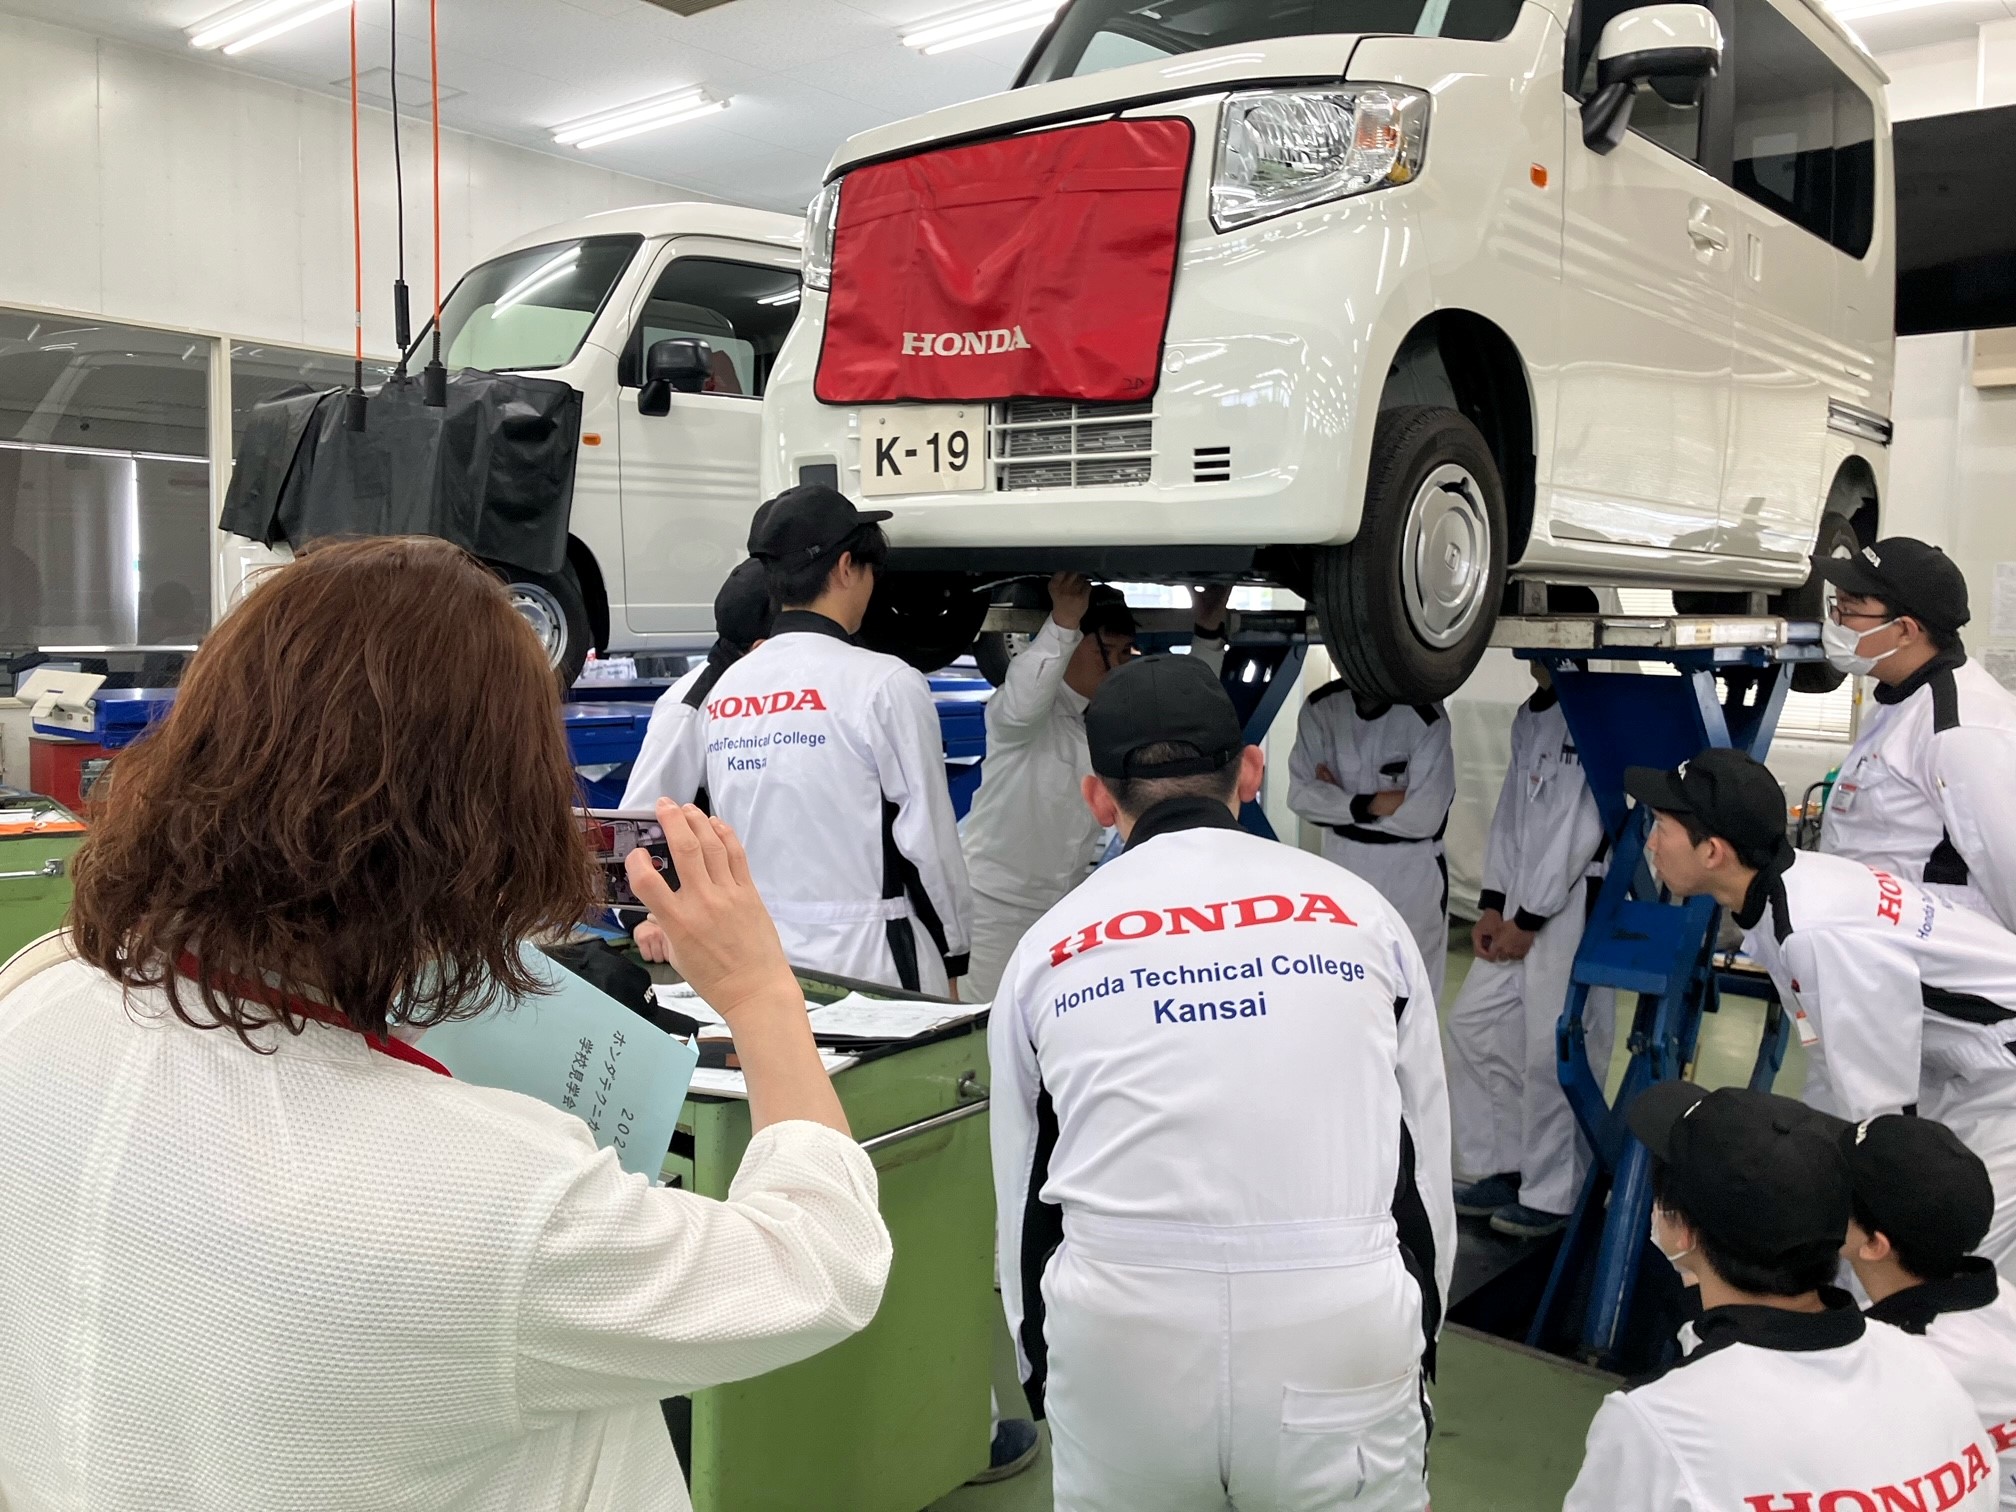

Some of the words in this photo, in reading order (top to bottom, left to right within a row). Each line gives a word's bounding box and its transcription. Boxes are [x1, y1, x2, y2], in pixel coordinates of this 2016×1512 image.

[901, 325, 1031, 356] HONDA
[875, 430, 969, 477] K-19
[706, 688, 827, 721] HONDA
[773, 731, 826, 747] College
[727, 756, 767, 771] Kansa
[1049, 893, 1358, 967] HONDA
[1054, 976, 1125, 1018] Honda
[1130, 957, 1264, 988] Technical
[1271, 954, 1365, 981] College
[1153, 991, 1267, 1024] Kansai
[614, 1107, 634, 1160] 202
